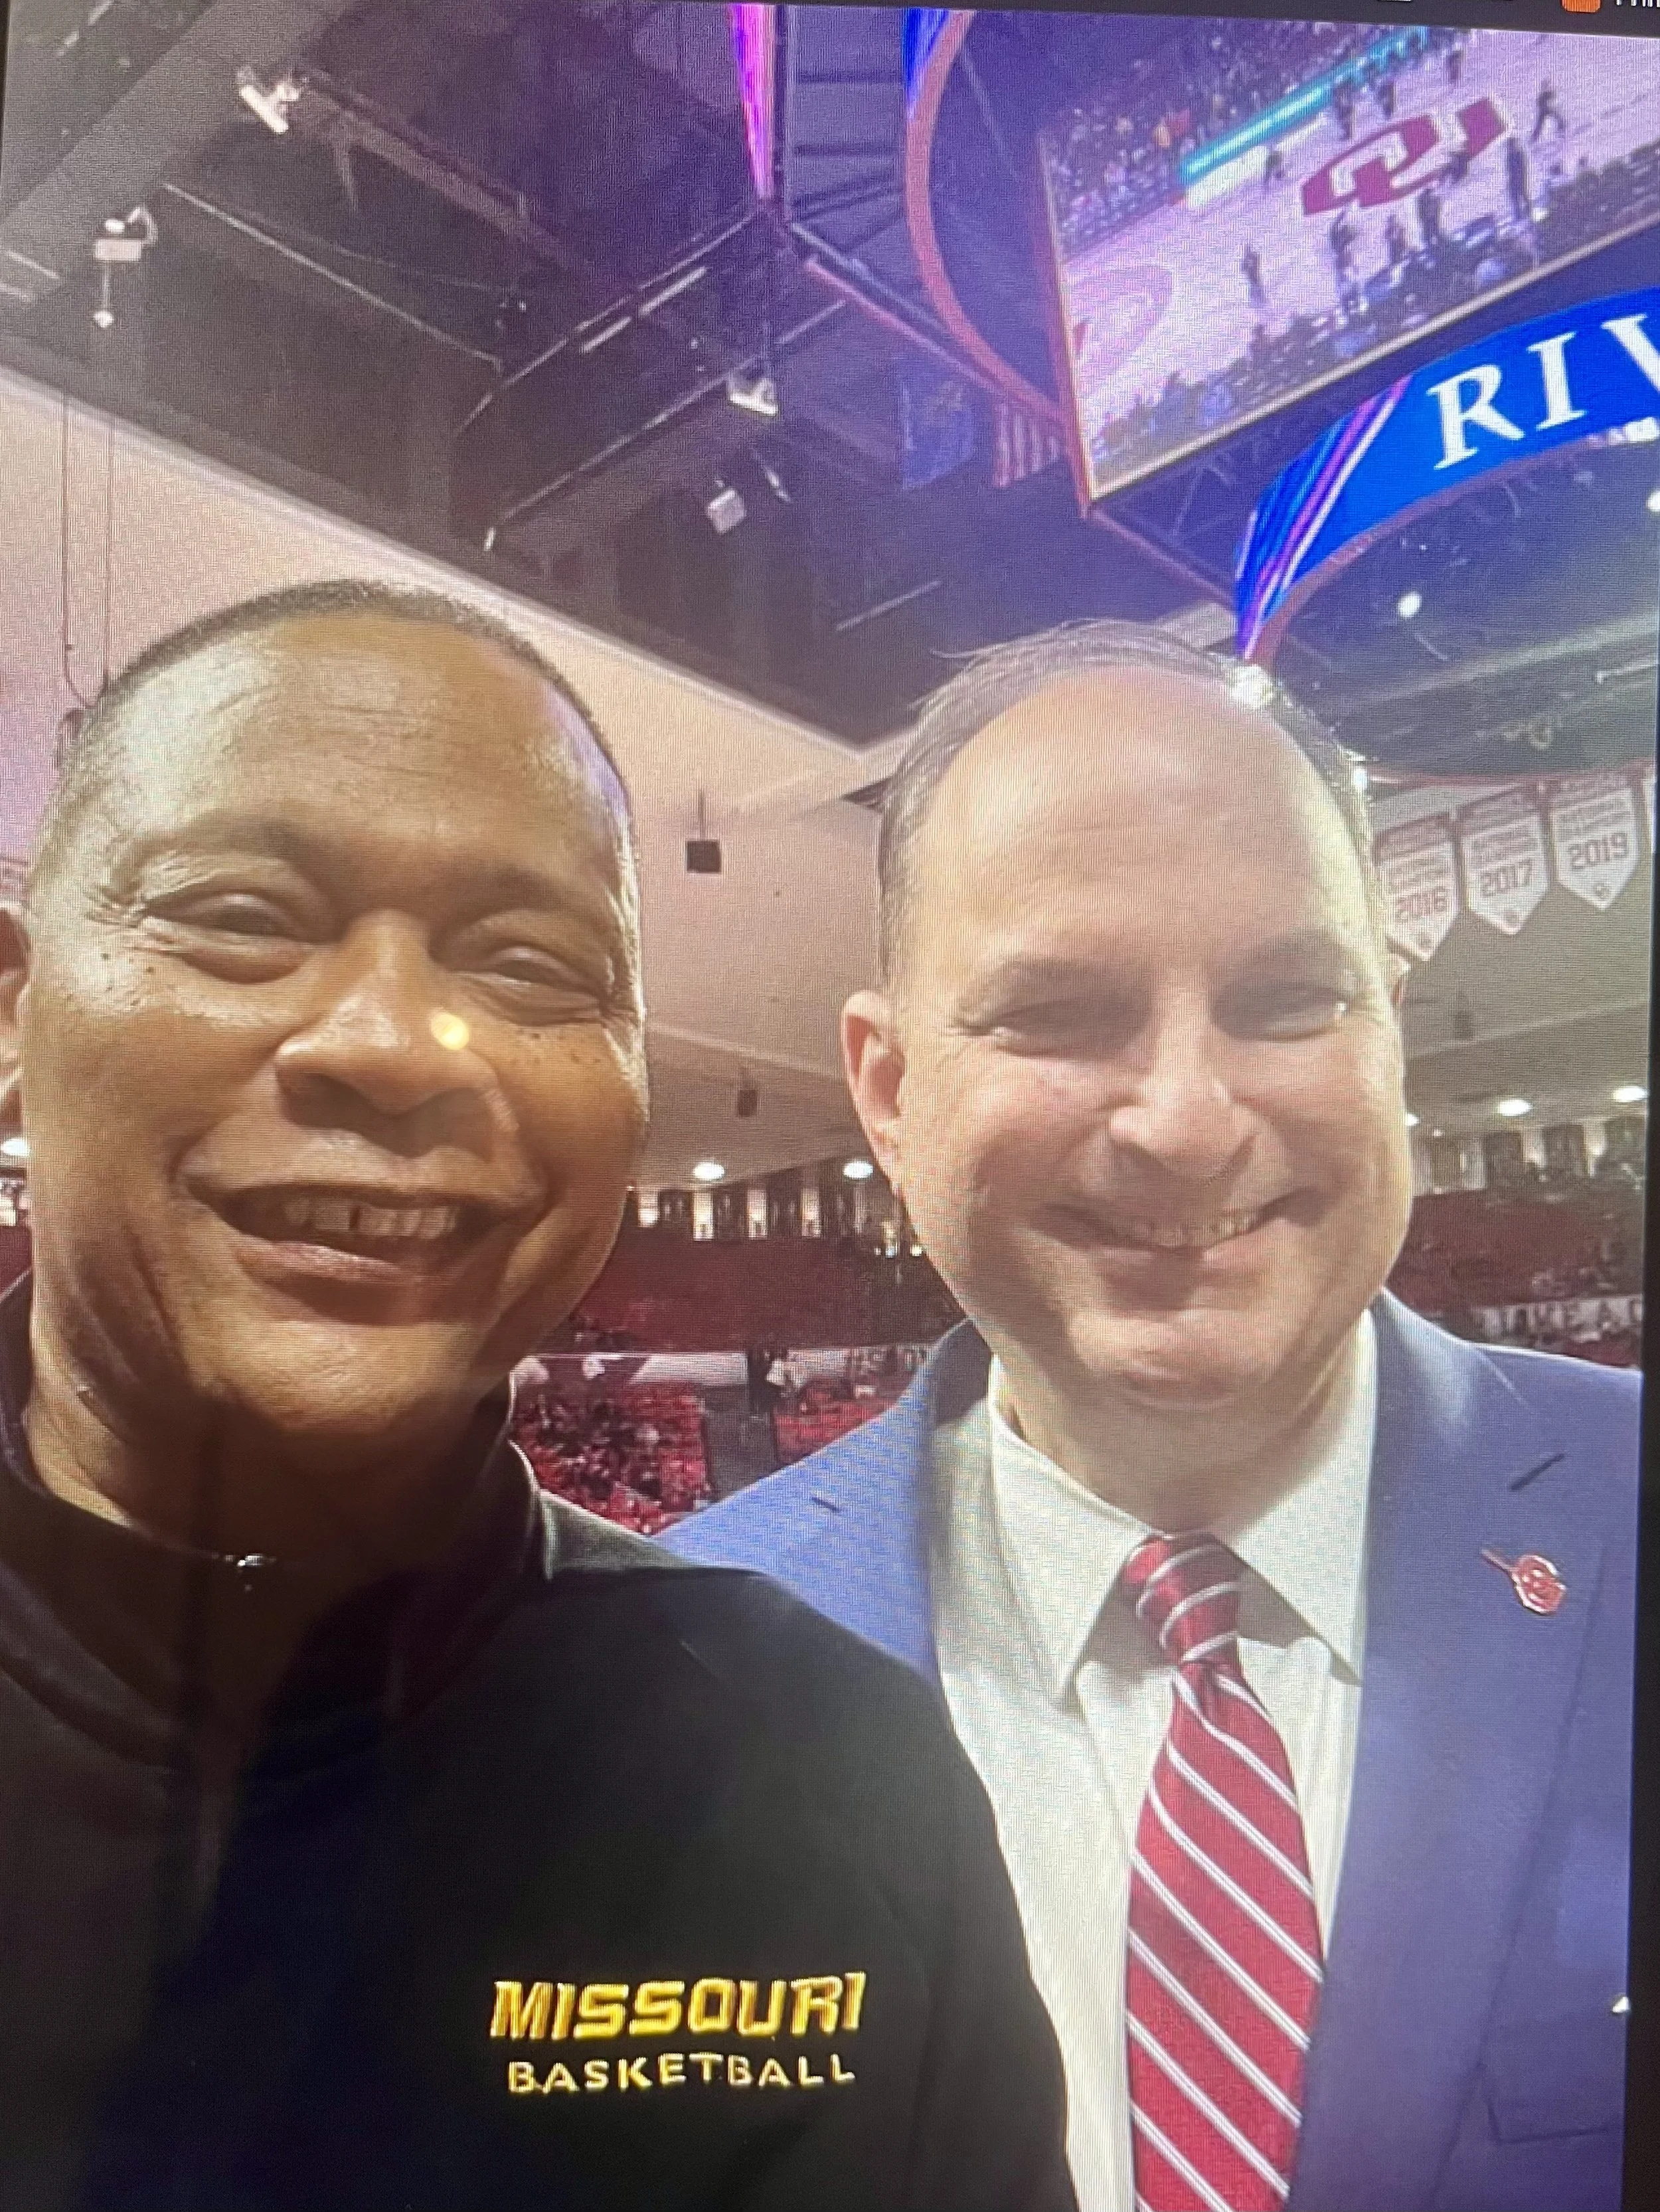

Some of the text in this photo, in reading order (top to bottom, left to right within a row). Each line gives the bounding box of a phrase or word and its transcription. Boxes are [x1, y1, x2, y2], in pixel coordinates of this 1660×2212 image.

[1568, 832, 1629, 871] 2019
[1481, 858, 1533, 898] 2017
[1396, 887, 1448, 922] 2016
[490, 1971, 866, 2039] MISSOURI
[508, 2053, 855, 2094] BASKETBALL
